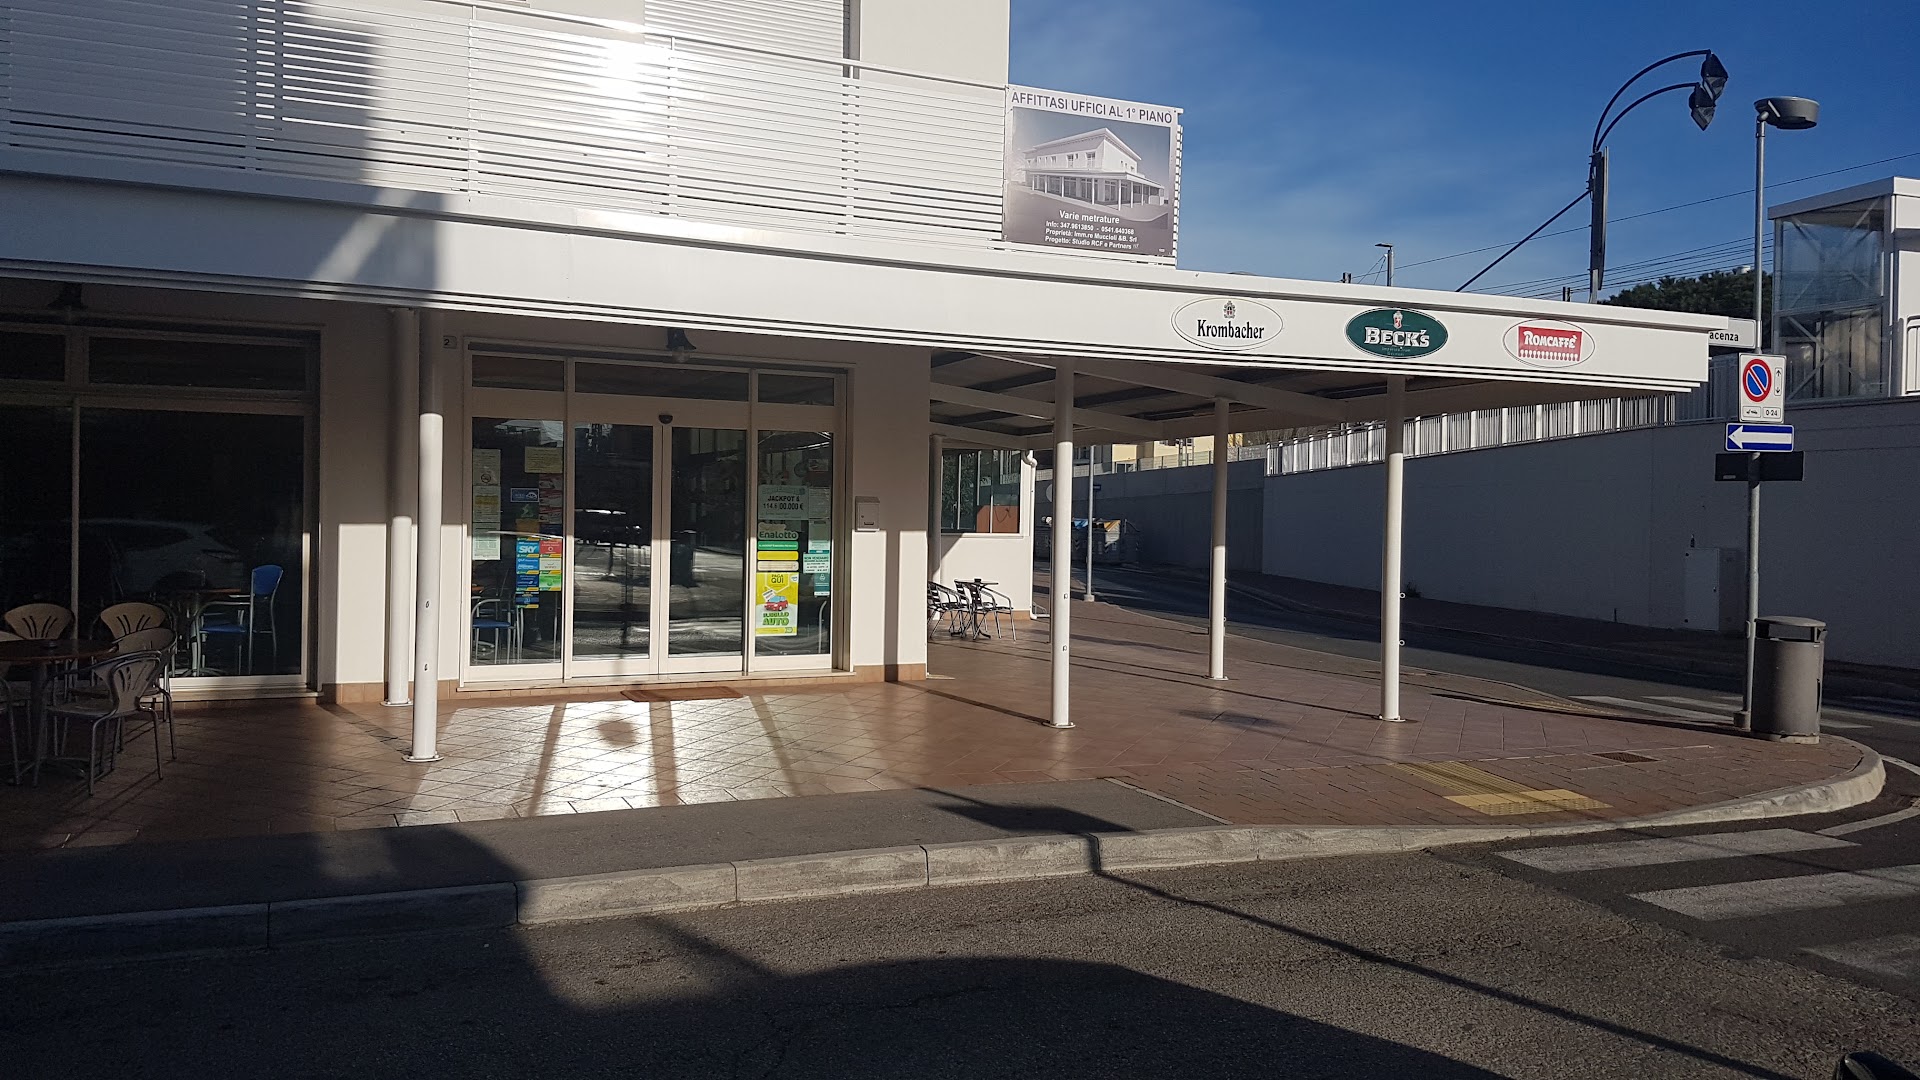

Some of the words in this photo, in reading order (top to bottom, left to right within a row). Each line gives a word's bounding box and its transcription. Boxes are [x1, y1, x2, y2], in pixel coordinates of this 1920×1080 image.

[1011, 91, 1068, 110] AFFITTASI
[1071, 100, 1106, 116] UFFICI
[1108, 105, 1123, 118] AL
[1126, 107, 1136, 119] 1°
[1139, 109, 1172, 124] PIANO
[1059, 209, 1080, 221] Varie
[1081, 213, 1120, 224] metrature
[1045, 220, 1059, 228] Info:
[1045, 228, 1073, 237] Proprietà:
[1094, 233, 1118, 241] Muccioli
[1045, 235, 1071, 244] Progetto:
[1071, 238, 1090, 246] Studio
[1091, 239, 1103, 247] RCF
[1108, 241, 1132, 249] Partners
[1197, 319, 1264, 339] Krombacher
[759, 531, 797, 539] Enalotto
[518, 545, 537, 553] SKY
[762, 618, 790, 626] AUTO
